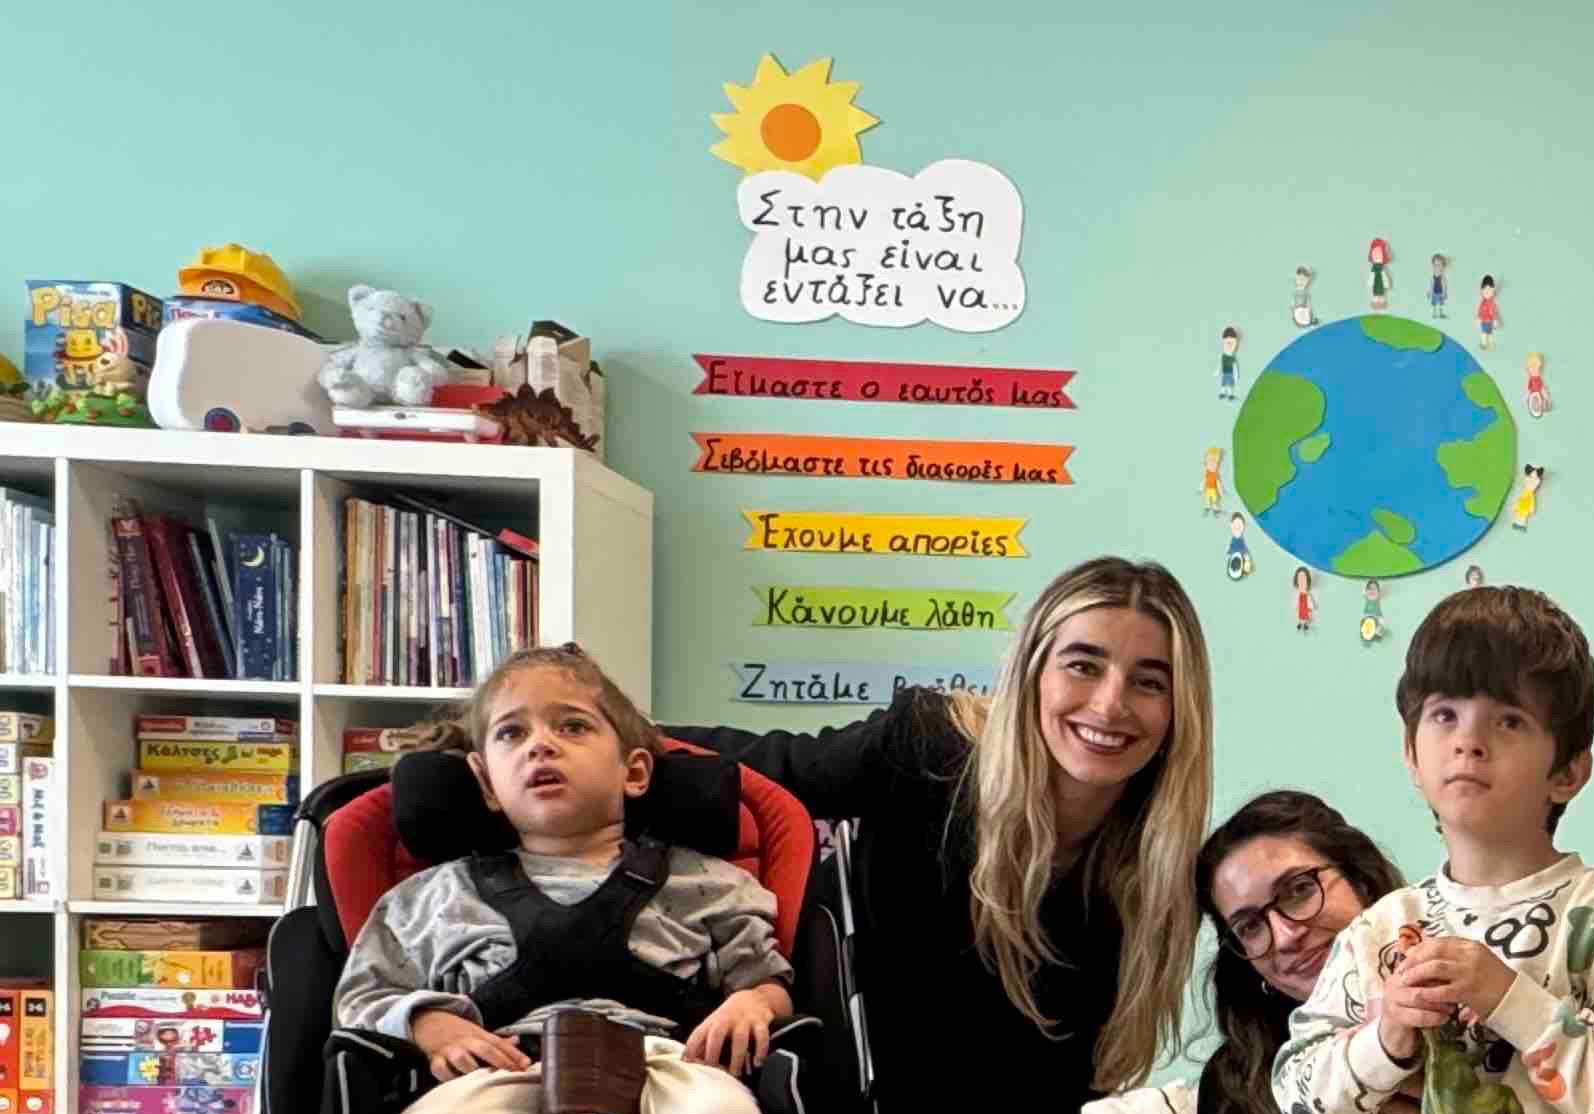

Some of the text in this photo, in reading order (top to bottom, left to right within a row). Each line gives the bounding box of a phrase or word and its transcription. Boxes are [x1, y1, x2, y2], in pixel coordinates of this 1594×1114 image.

[751, 189, 984, 238] Στην τάξη
[784, 237, 983, 280] μας είναι
[763, 272, 904, 307] εντάξει
[707, 360, 1062, 409] Είμαστε ο εαυτός μας
[703, 437, 1057, 484] Σεβόμαστε τις διαφορές μας
[758, 512, 1009, 557] Έχουμε απορίες
[766, 585, 995, 629] Κάνουμε λάθη
[740, 663, 870, 701] Ζητάμε
